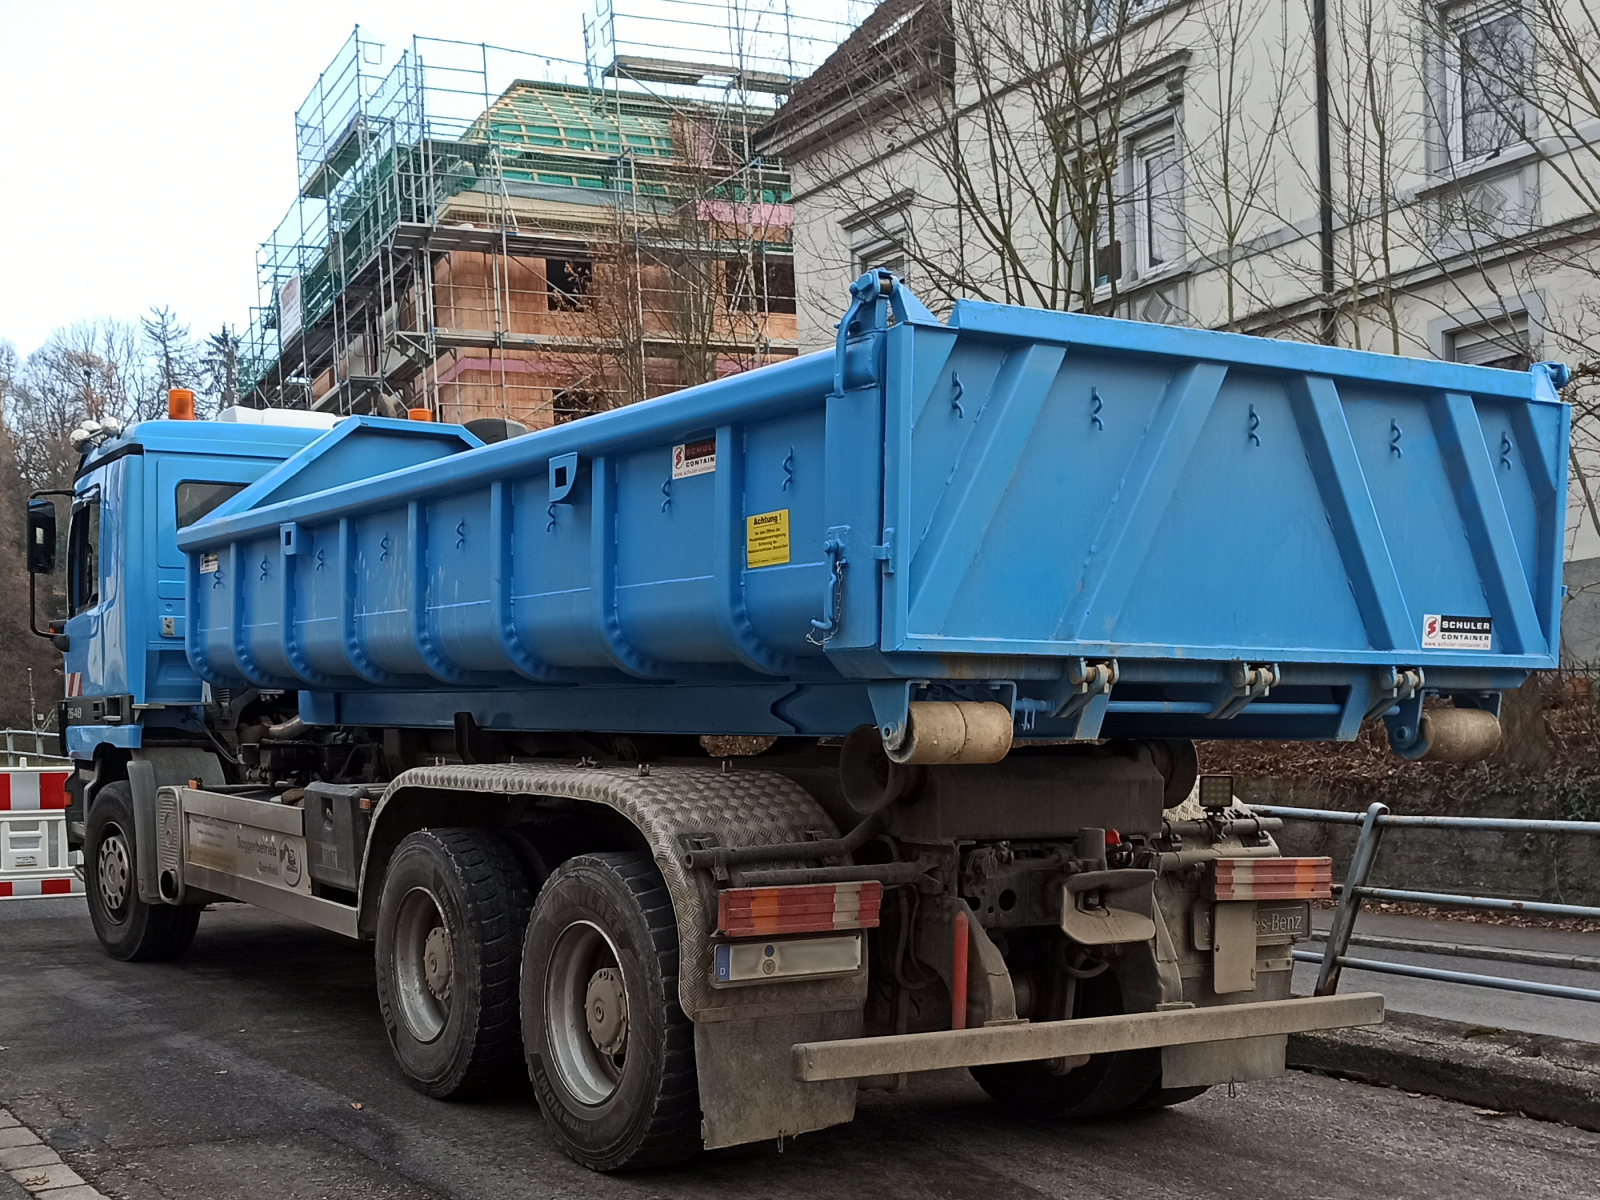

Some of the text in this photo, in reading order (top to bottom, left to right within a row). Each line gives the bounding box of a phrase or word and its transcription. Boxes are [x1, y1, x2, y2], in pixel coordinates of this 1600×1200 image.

[753, 515, 778, 526] Achtung
[1442, 621, 1490, 630] SCHULER
[719, 967, 726, 976] D
